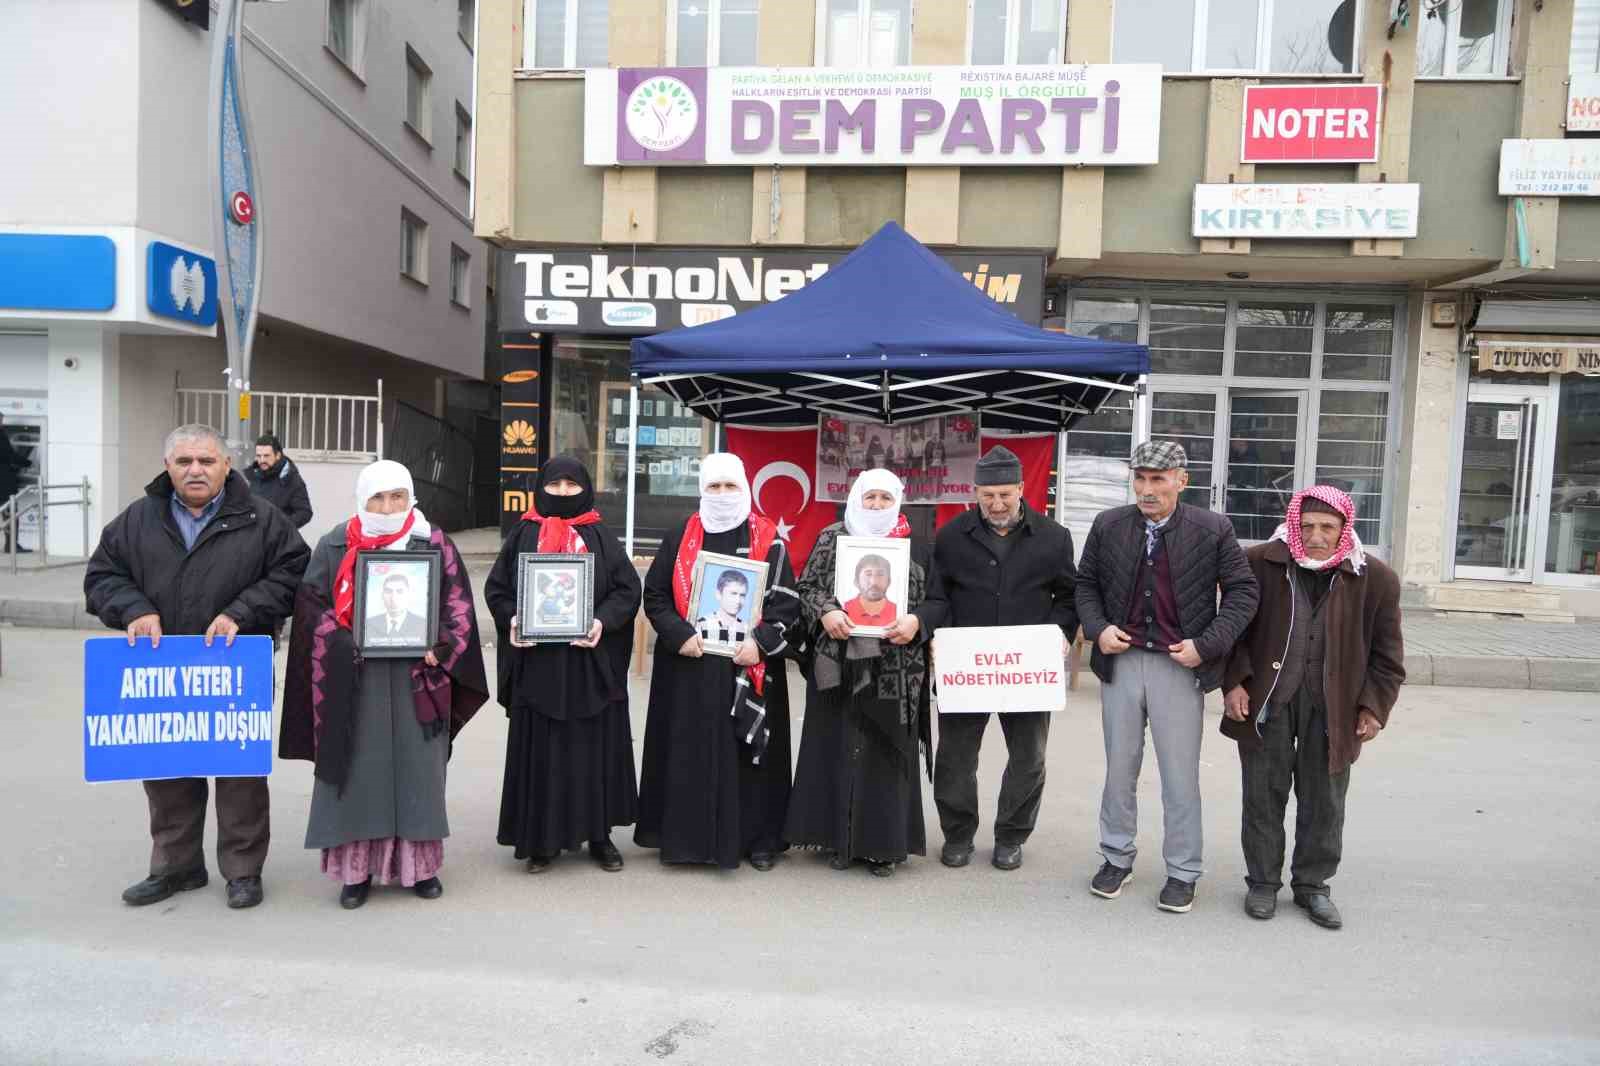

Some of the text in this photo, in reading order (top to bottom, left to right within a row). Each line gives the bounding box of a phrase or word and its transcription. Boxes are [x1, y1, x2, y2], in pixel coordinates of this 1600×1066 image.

[731, 80, 1121, 154] DEM PARTİ
[1252, 108, 1369, 138] NOTER
[1494, 348, 1563, 368] TÜTÜNCÜ
[974, 652, 1022, 666] EVLAT
[120, 666, 177, 699] ARTIK
[181, 666, 232, 696] YETER
[943, 668, 1058, 686] NÖBETİNDEYİZ
[86, 703, 271, 750] YAKAMIZDAN DÜŞÜN
